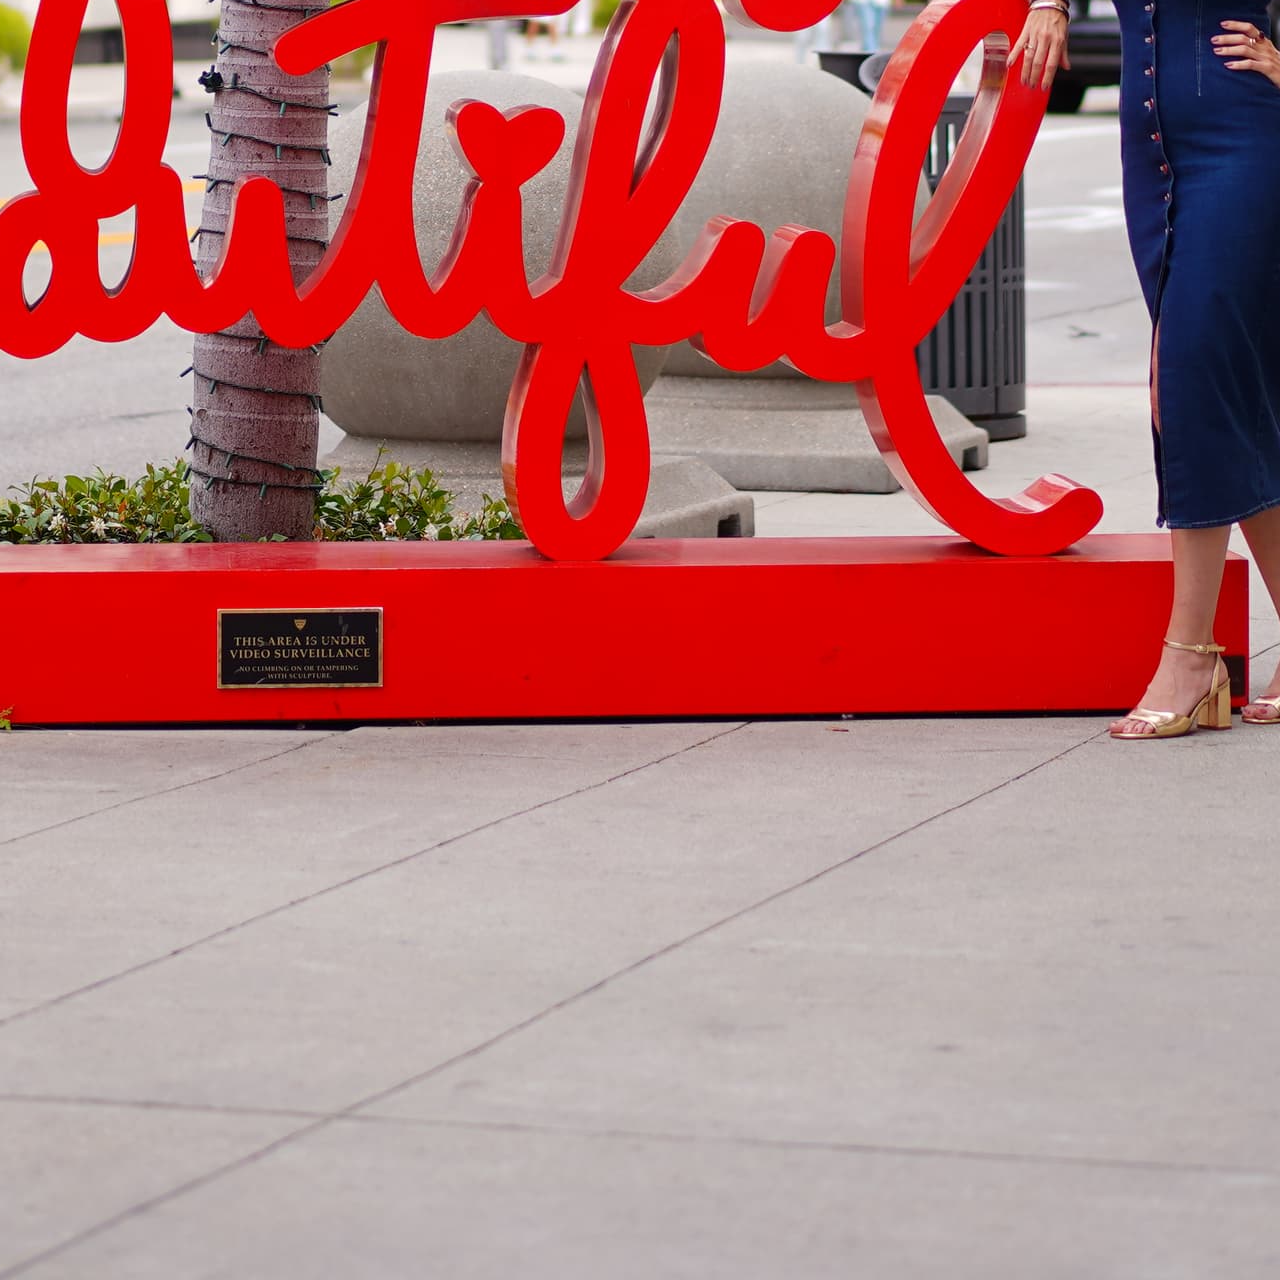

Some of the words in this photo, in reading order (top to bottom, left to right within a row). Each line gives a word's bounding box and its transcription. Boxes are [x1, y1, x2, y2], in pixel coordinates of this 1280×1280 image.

[234, 636, 264, 647] THIS
[269, 636, 301, 647] AREA
[305, 636, 318, 646] IS
[321, 635, 366, 646] UNDER
[230, 649, 270, 659] VIDEO
[274, 647, 371, 659] SURVEILLANCE
[290, 664, 302, 672] ON
[317, 664, 359, 672] TAMPERING
[267, 672, 288, 680] WITH
